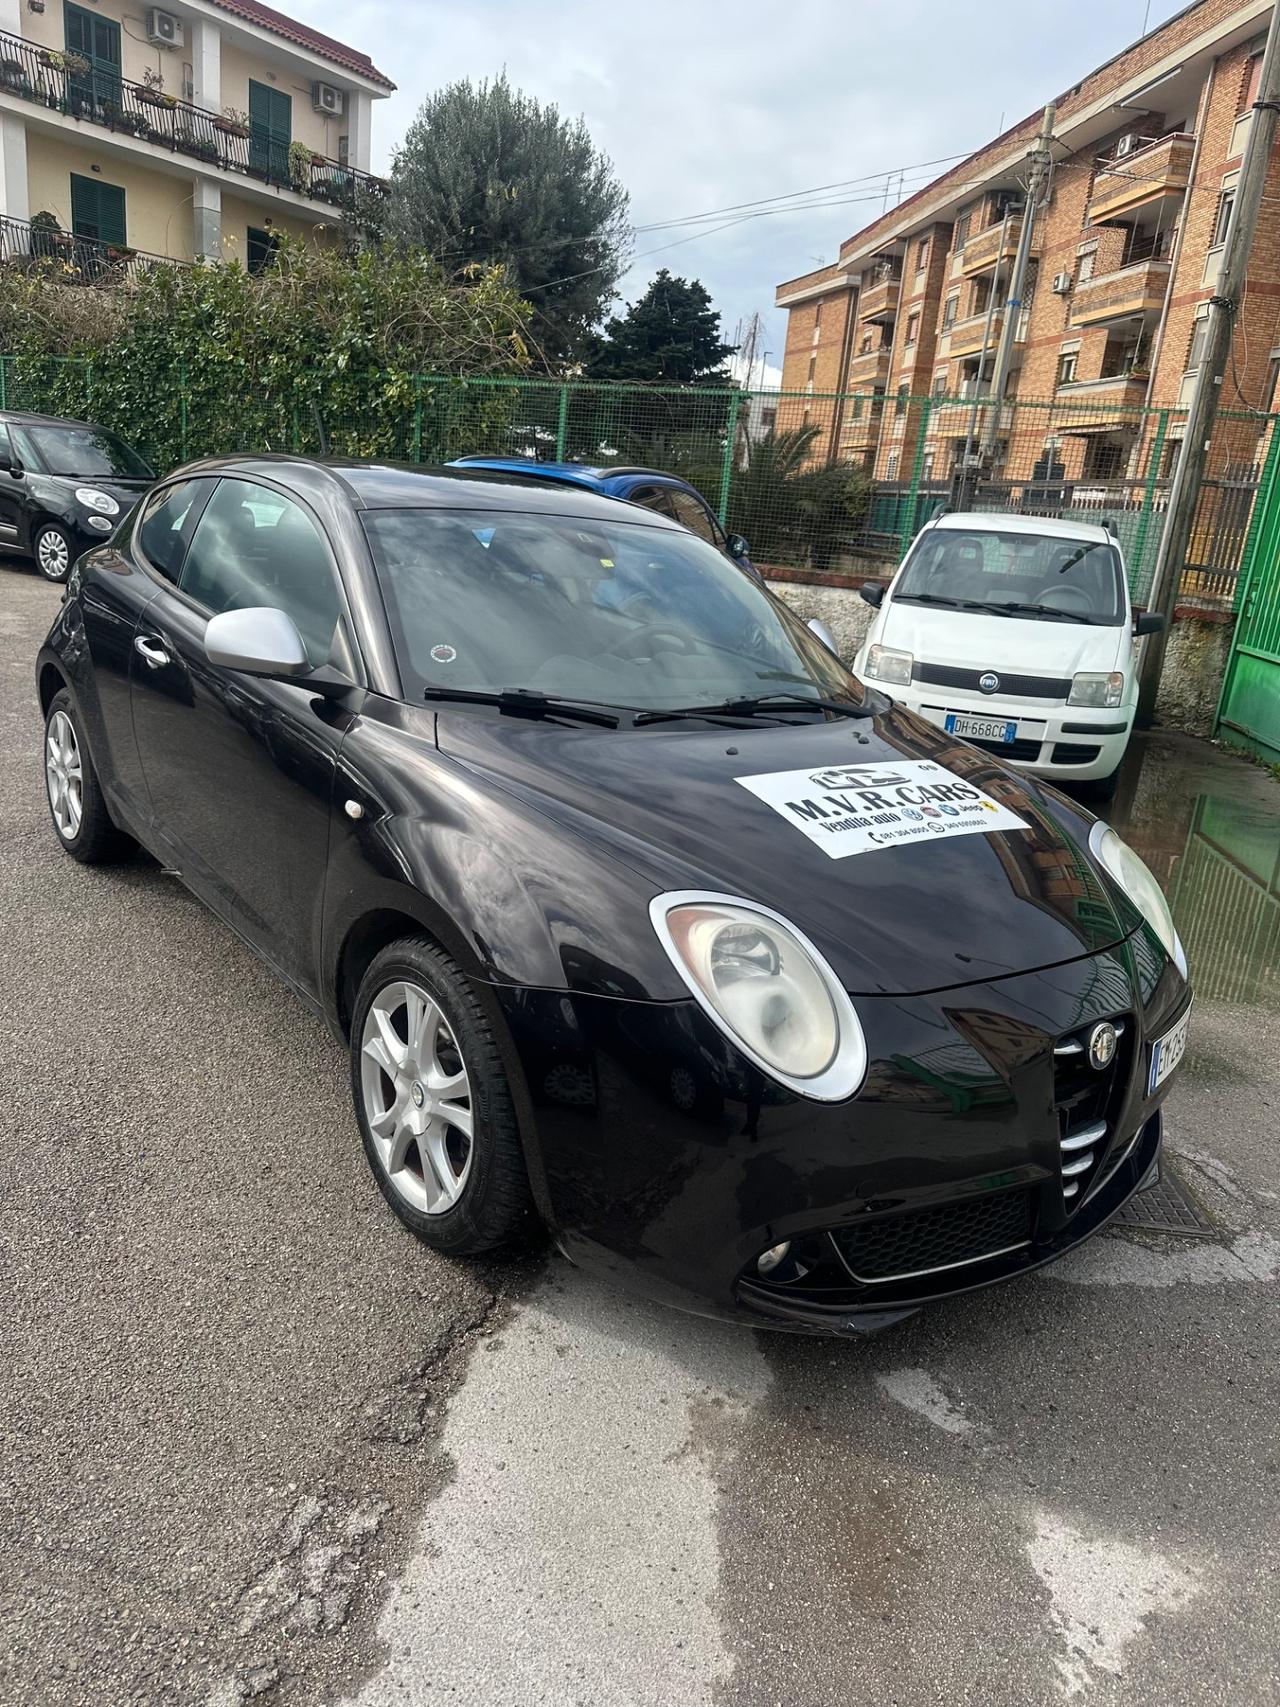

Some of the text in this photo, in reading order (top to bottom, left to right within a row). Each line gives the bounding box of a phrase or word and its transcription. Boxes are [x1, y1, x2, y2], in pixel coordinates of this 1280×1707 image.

[958, 803, 984, 812] Jeep
[818, 811, 902, 833] Vendita auto
